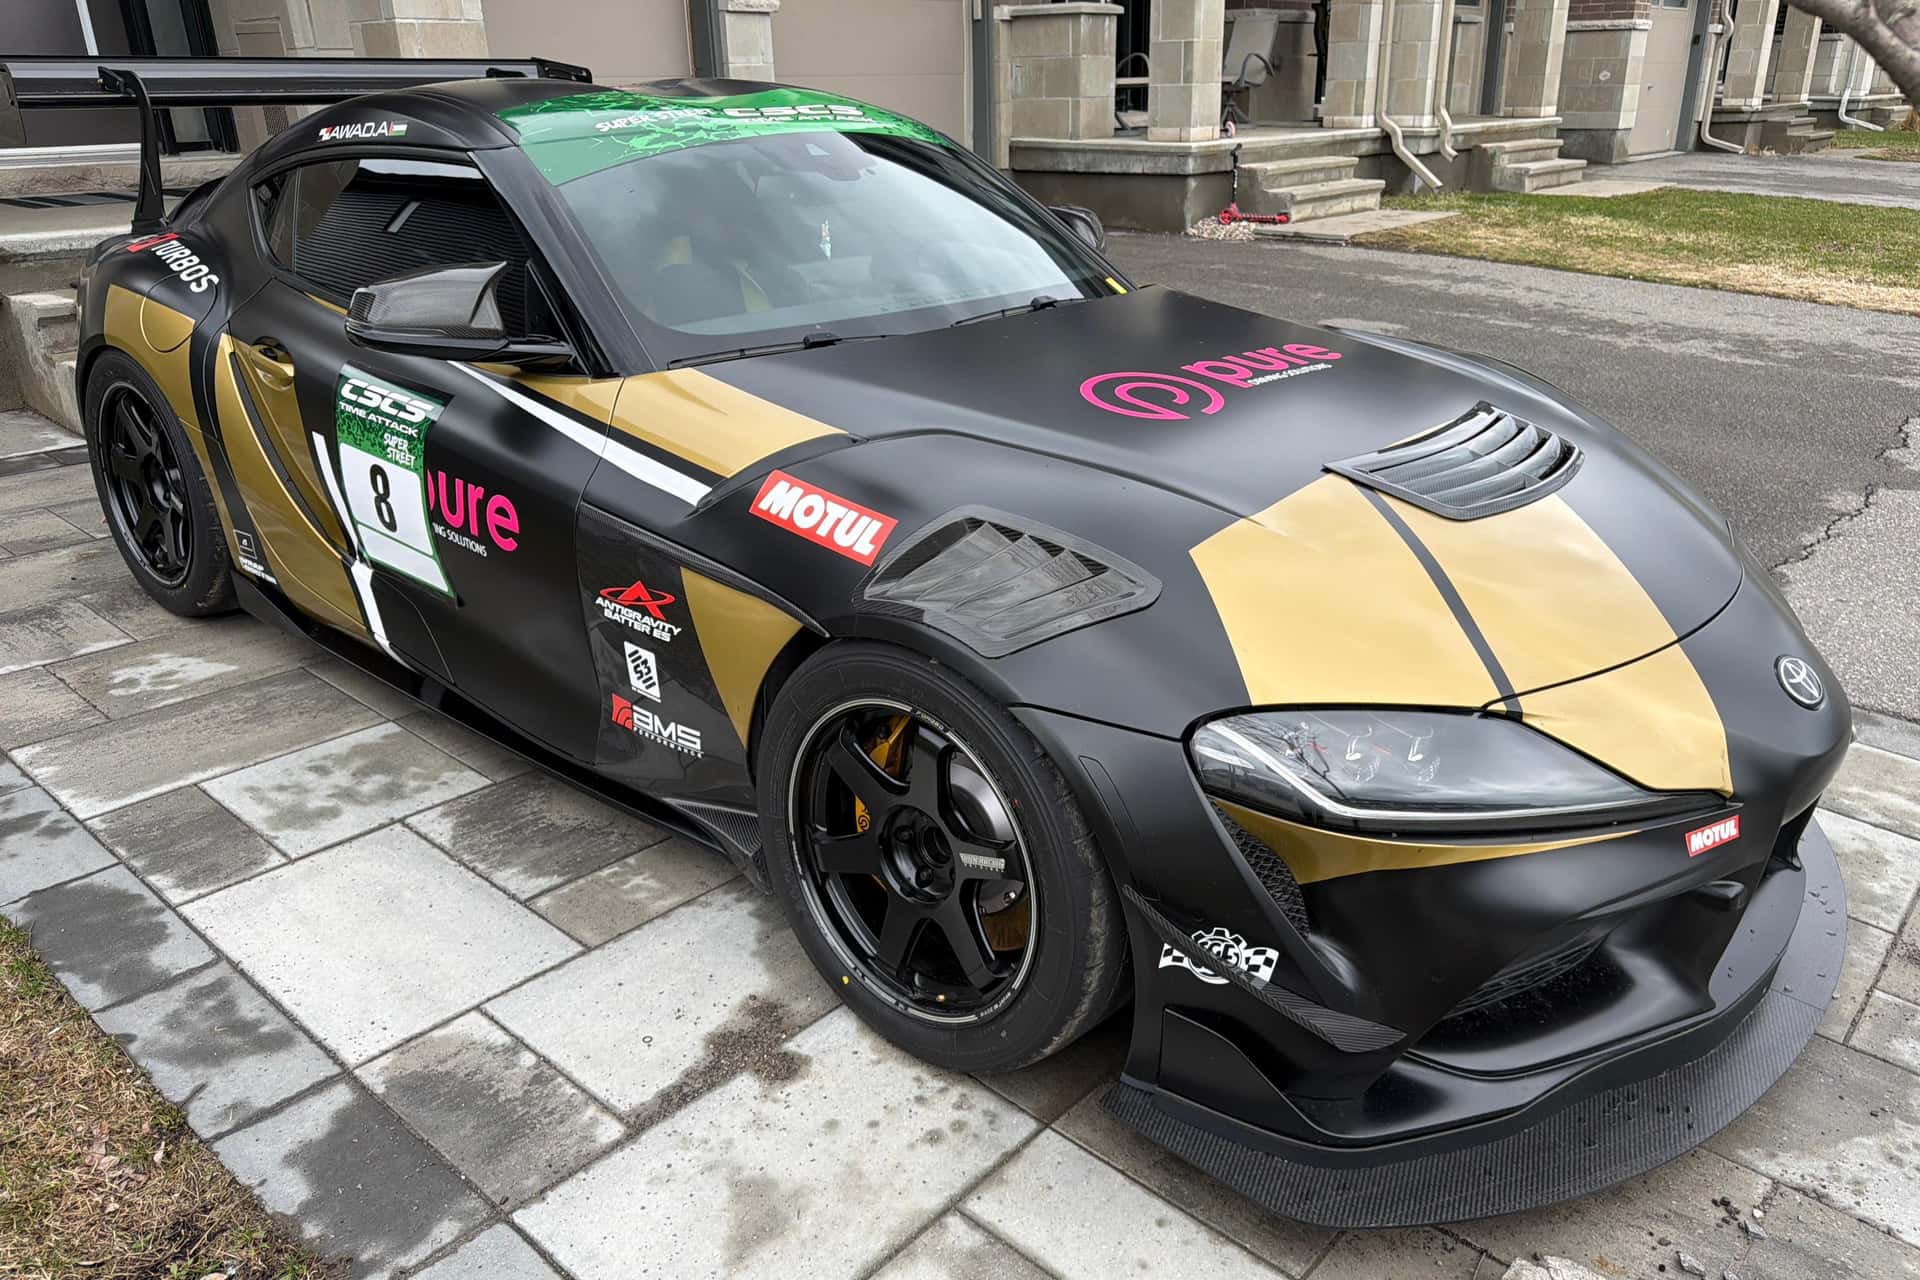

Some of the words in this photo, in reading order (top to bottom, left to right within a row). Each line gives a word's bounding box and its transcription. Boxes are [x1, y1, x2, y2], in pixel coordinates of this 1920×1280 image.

[151, 240, 220, 293] TURBOS
[1181, 343, 1342, 389] pure
[338, 401, 366, 418] TIME
[368, 410, 419, 438] ATTACK
[340, 378, 434, 423] CSCS
[383, 432, 409, 451] SUPER
[386, 446, 416, 468] STREET
[369, 463, 398, 533] 8
[757, 480, 884, 556] MOTUL
[446, 529, 488, 557] SOLUTIONS
[595, 597, 682, 636] ANTIGRAVITY
[1690, 819, 1738, 853] MOTUL
